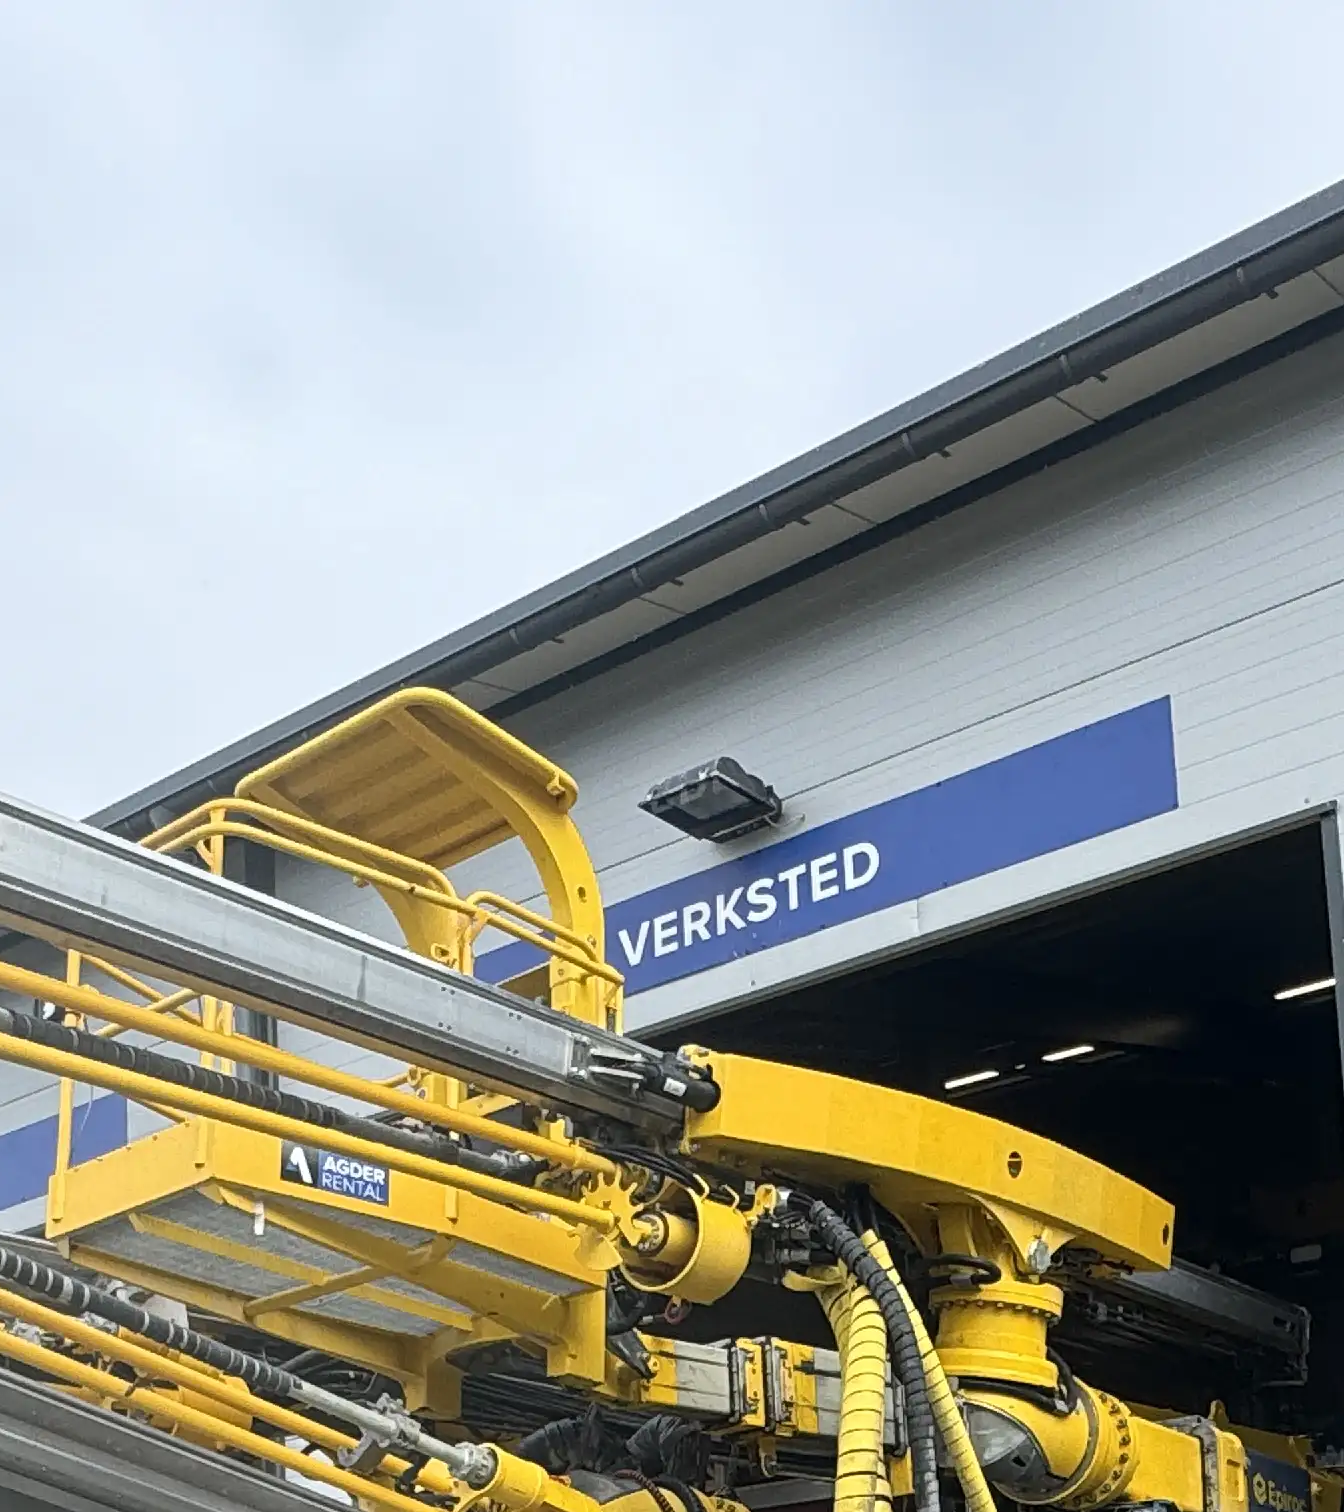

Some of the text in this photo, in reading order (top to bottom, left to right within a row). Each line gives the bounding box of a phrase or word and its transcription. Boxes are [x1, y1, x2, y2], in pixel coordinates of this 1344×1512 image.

[618, 842, 881, 967] VERKSTED
[322, 1156, 386, 1186] AGDER
[321, 1172, 385, 1202] RENTAL
